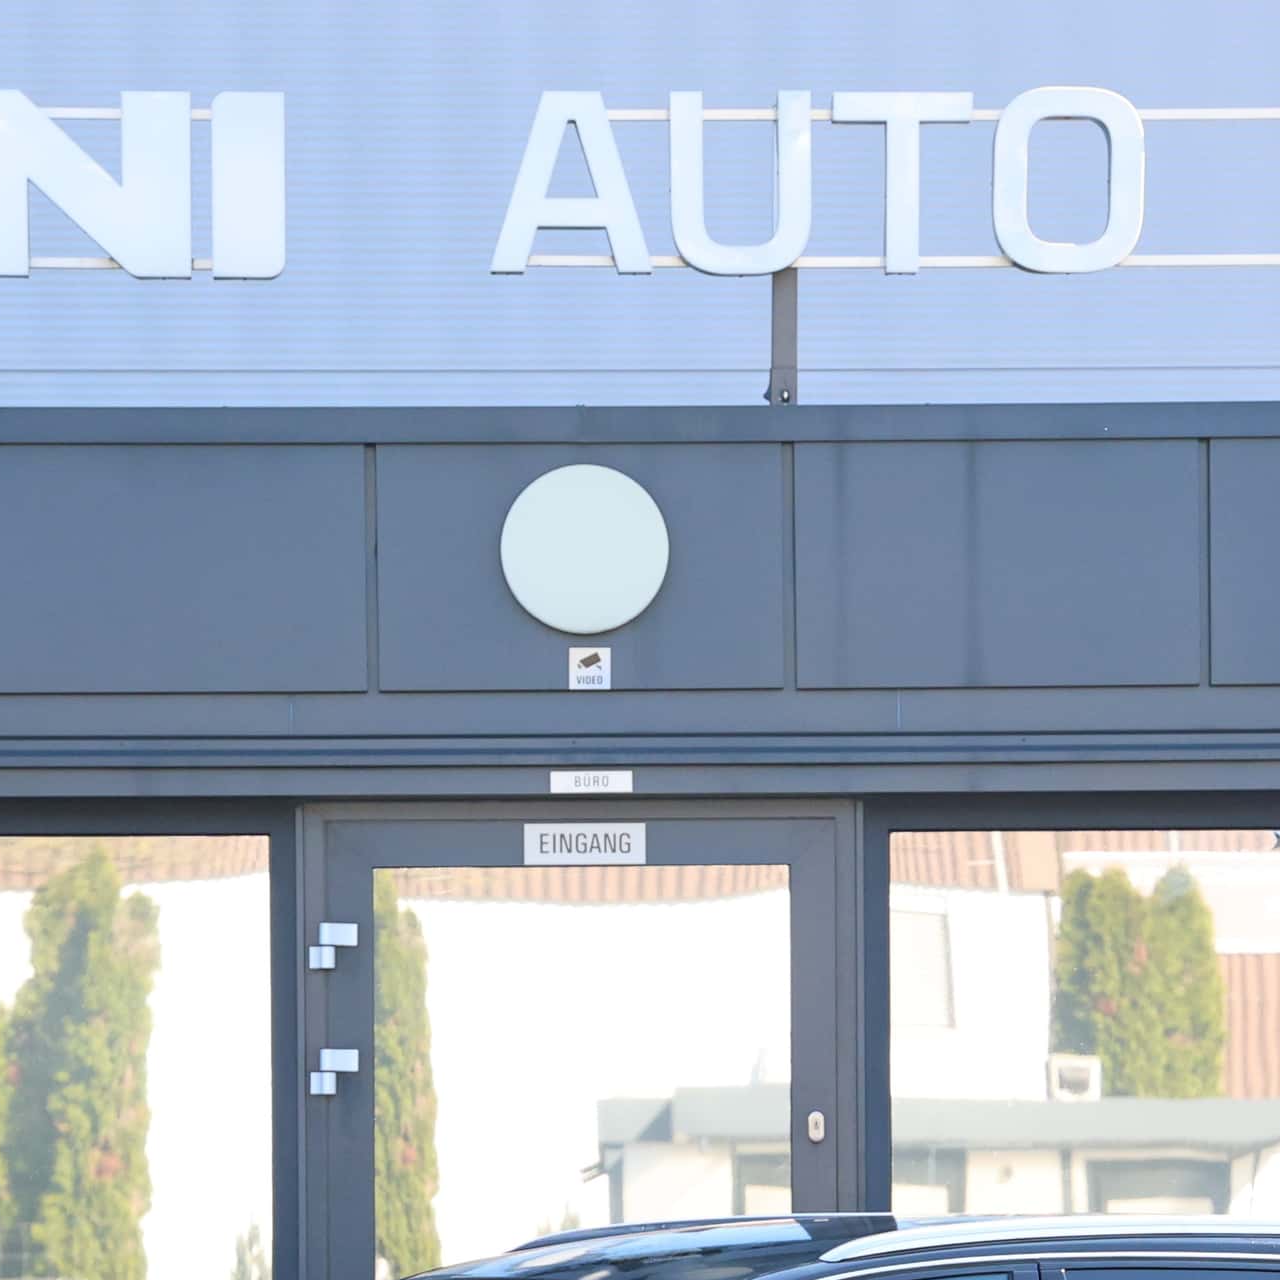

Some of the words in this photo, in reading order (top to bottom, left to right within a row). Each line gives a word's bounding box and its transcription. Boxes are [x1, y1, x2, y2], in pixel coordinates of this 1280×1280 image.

[489, 87, 1146, 277] AUTO
[576, 676, 603, 685] VIDEO
[574, 774, 609, 788] BÜRO
[539, 833, 631, 854] EINGANG
